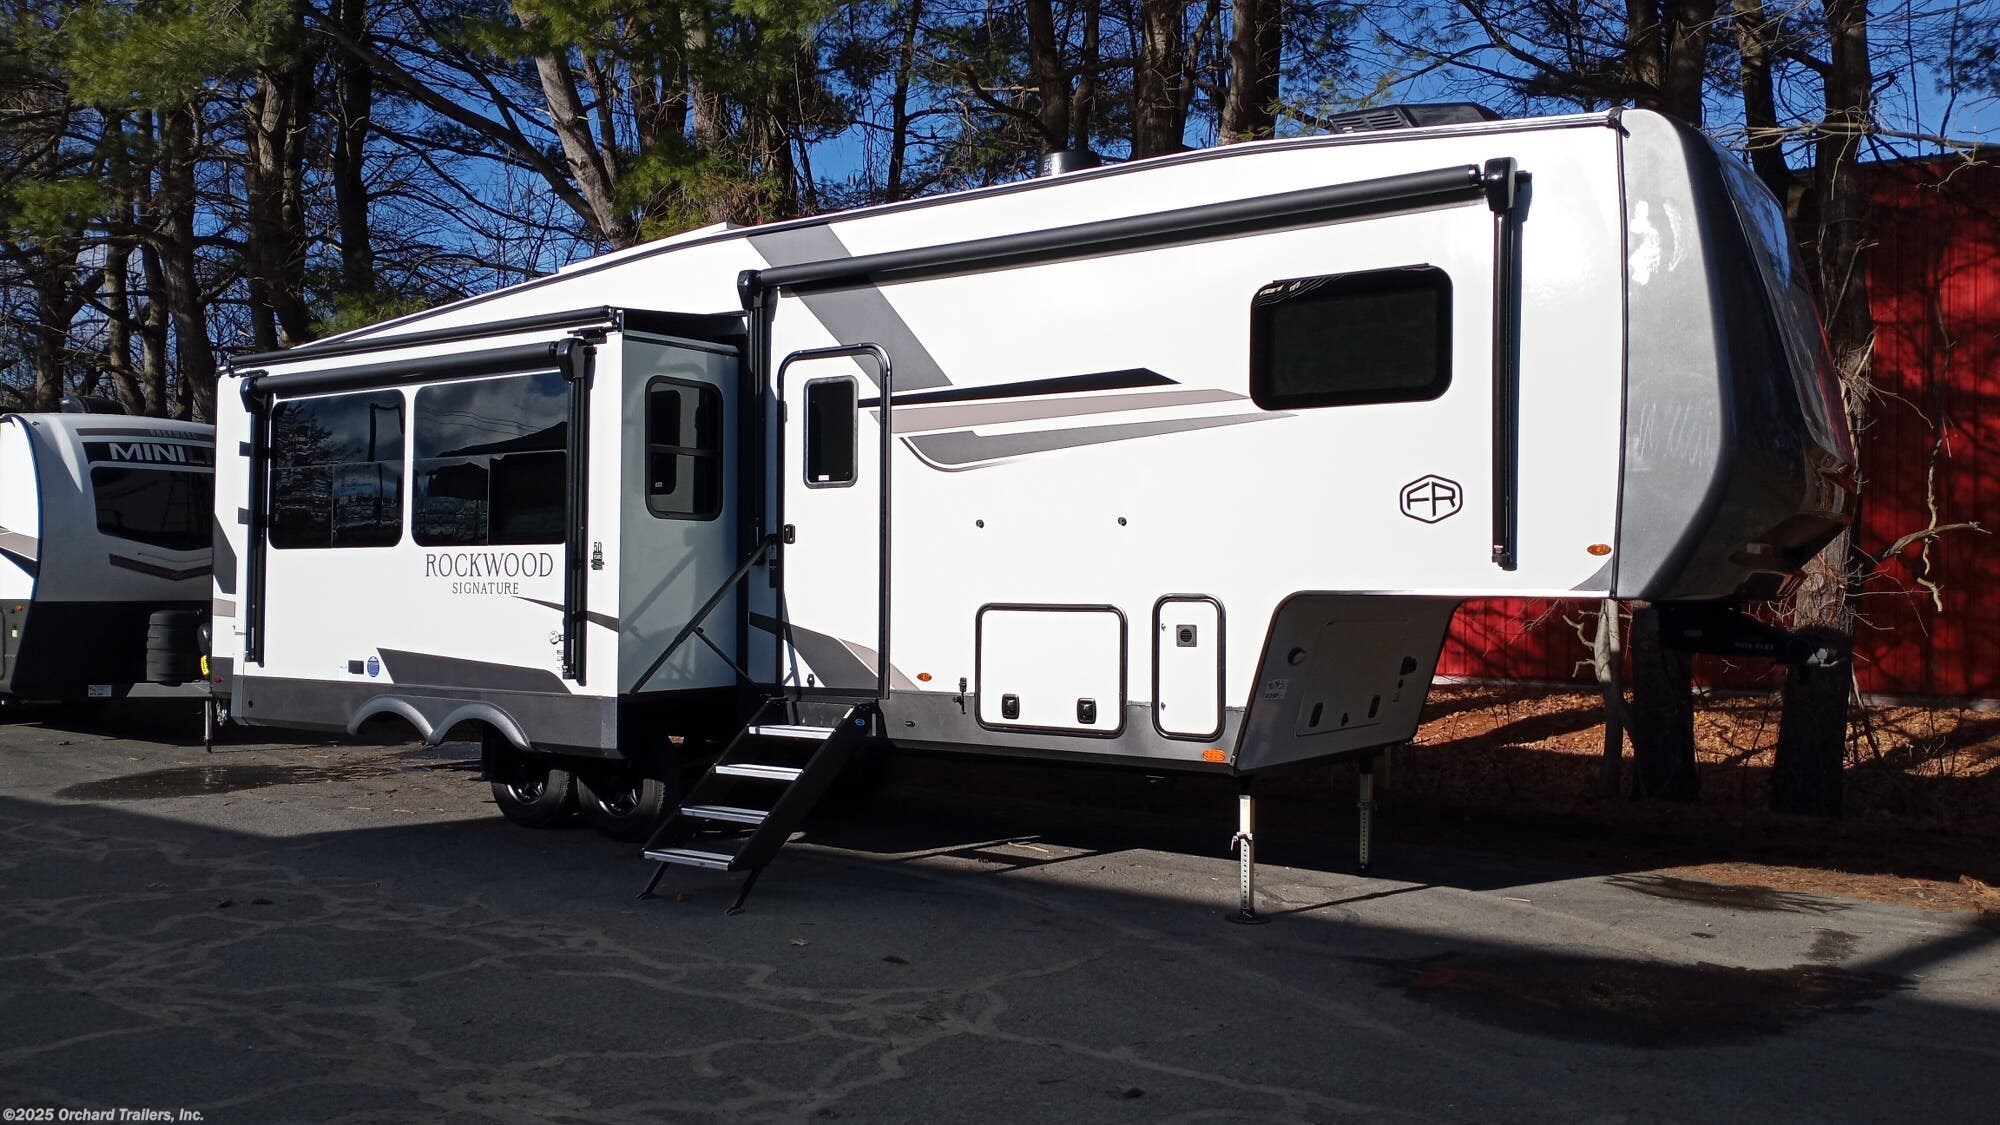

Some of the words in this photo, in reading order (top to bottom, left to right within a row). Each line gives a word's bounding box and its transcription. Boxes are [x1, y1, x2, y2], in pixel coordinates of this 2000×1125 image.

[109, 442, 186, 462] MINI
[425, 552, 554, 577] ROCKWOOD
[451, 582, 519, 595] SIGNATURE
